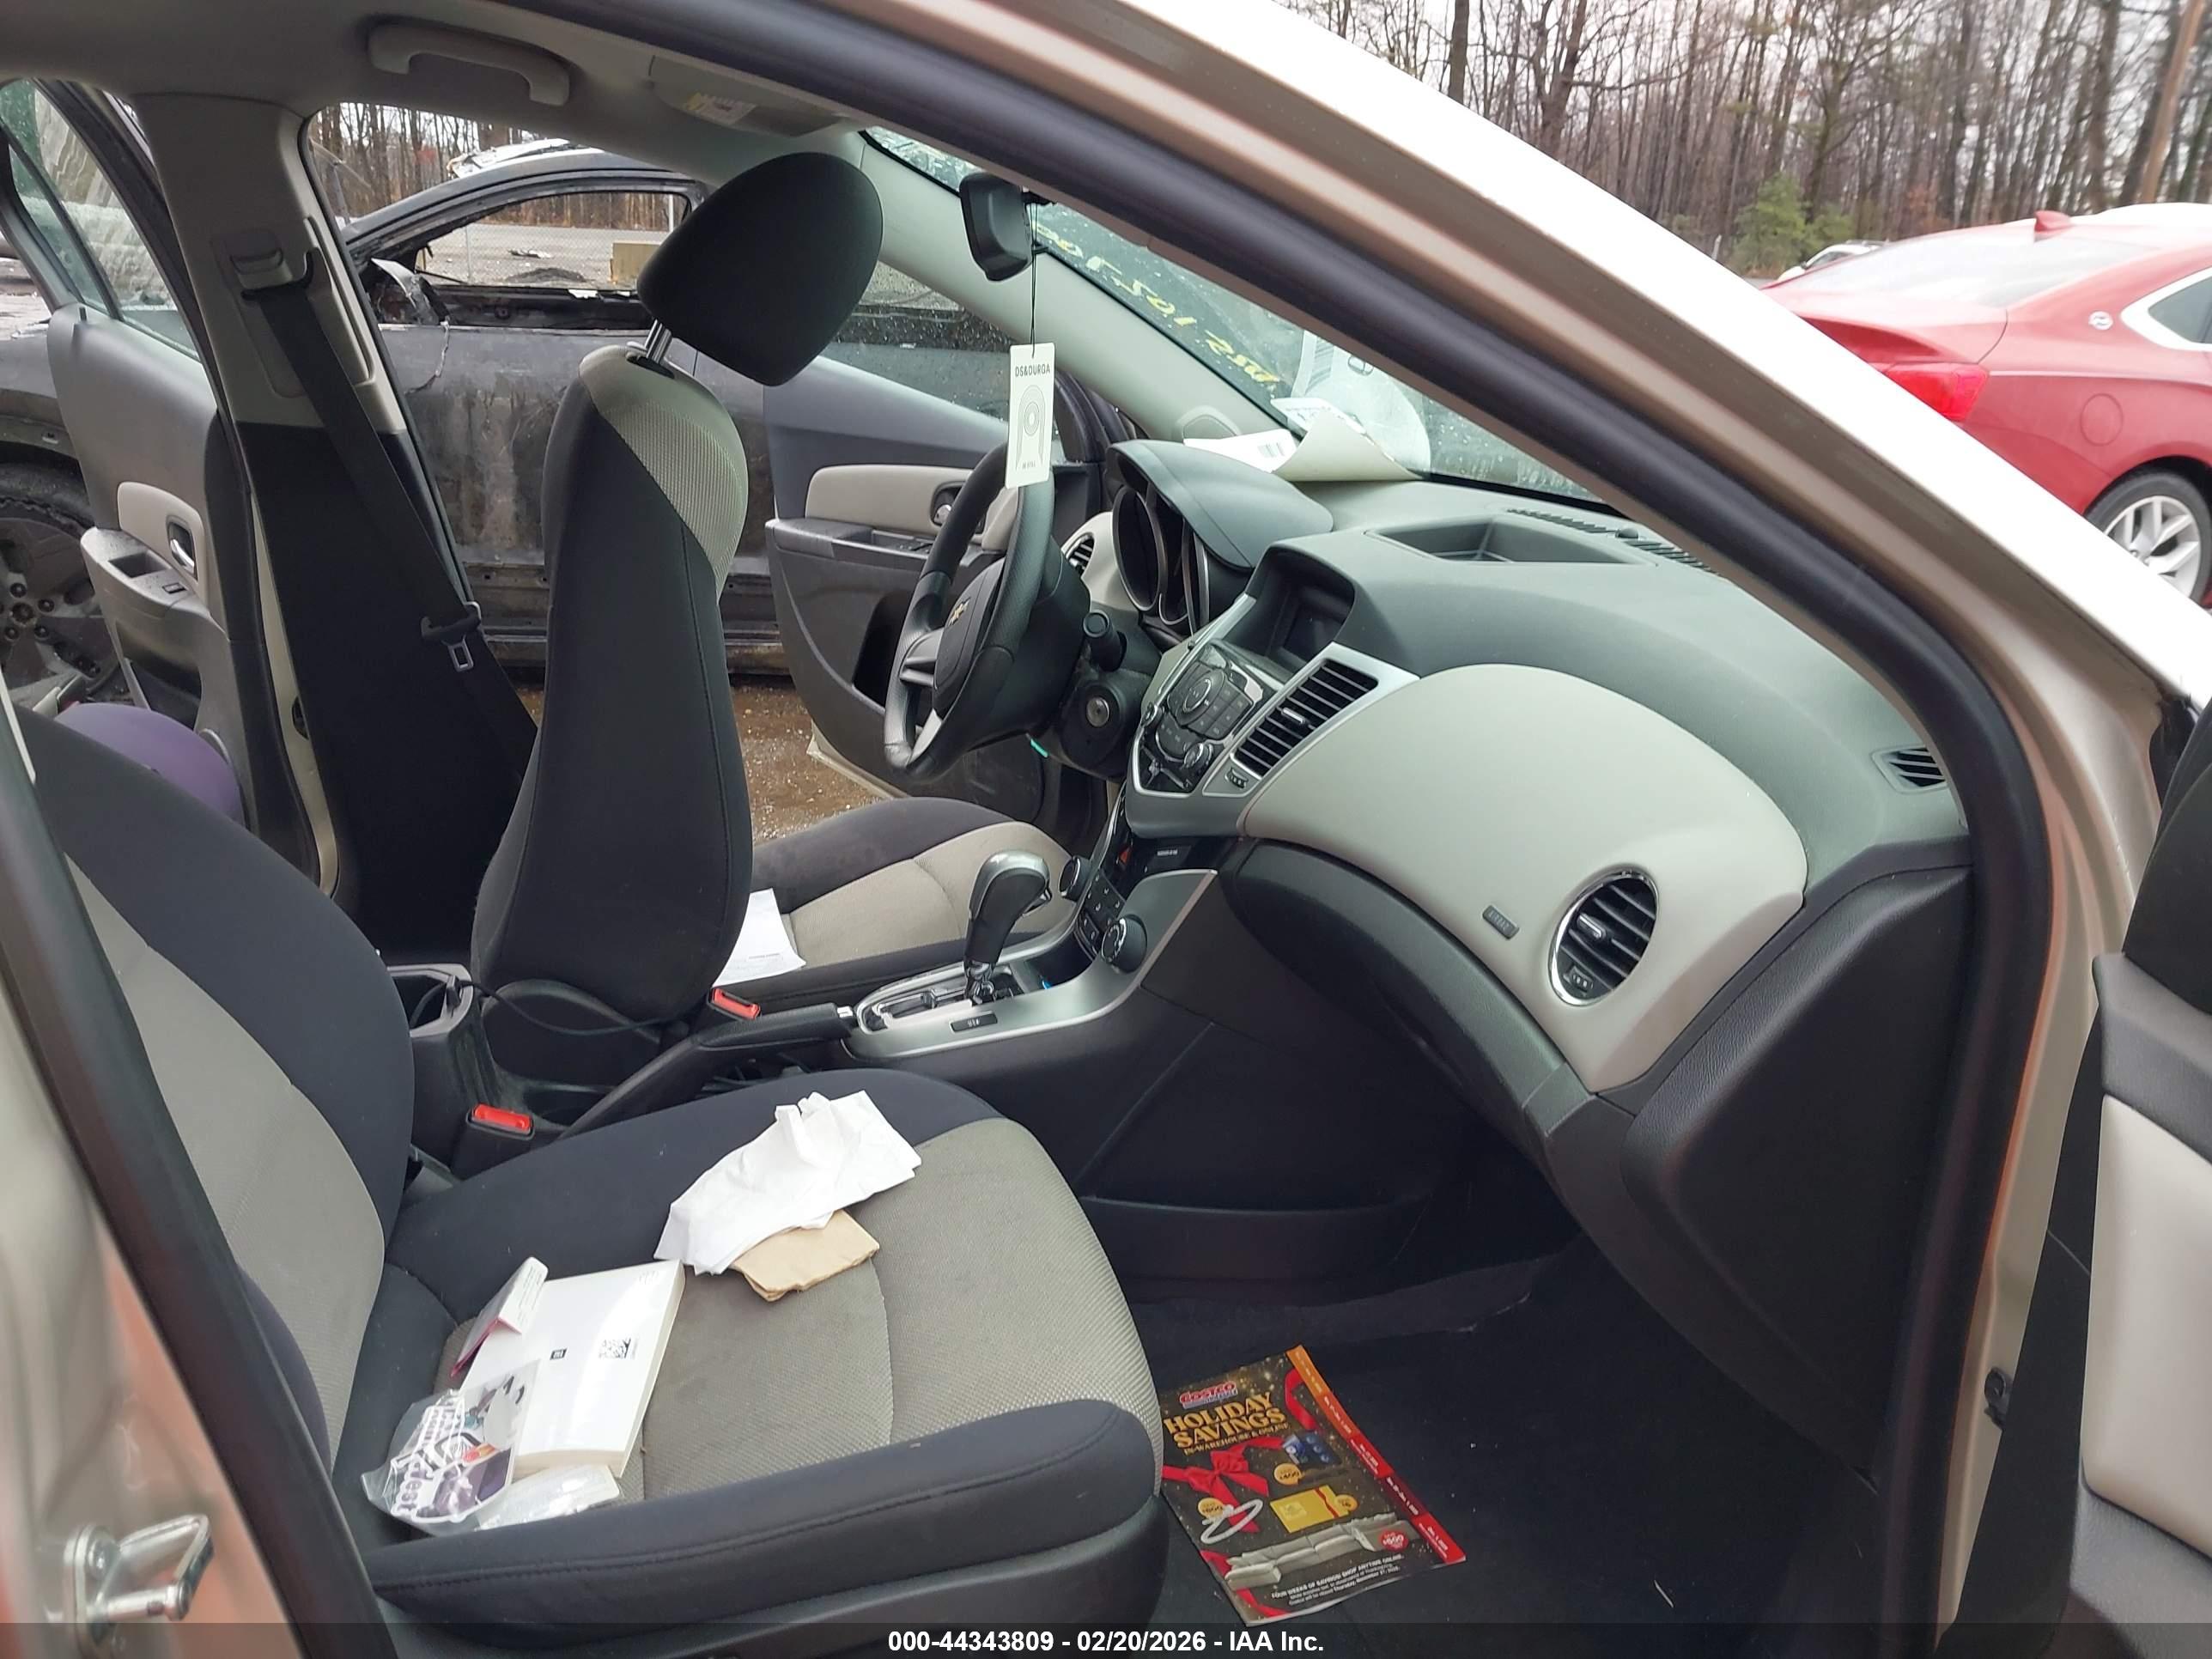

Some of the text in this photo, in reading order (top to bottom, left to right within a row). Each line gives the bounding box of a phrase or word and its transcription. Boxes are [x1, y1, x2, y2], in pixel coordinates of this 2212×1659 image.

[1015, 363, 1051, 377] DS&DURGA
[1164, 1392, 1273, 1434] HOLIDAY
[1173, 1407, 1286, 1449] SAVINGS
